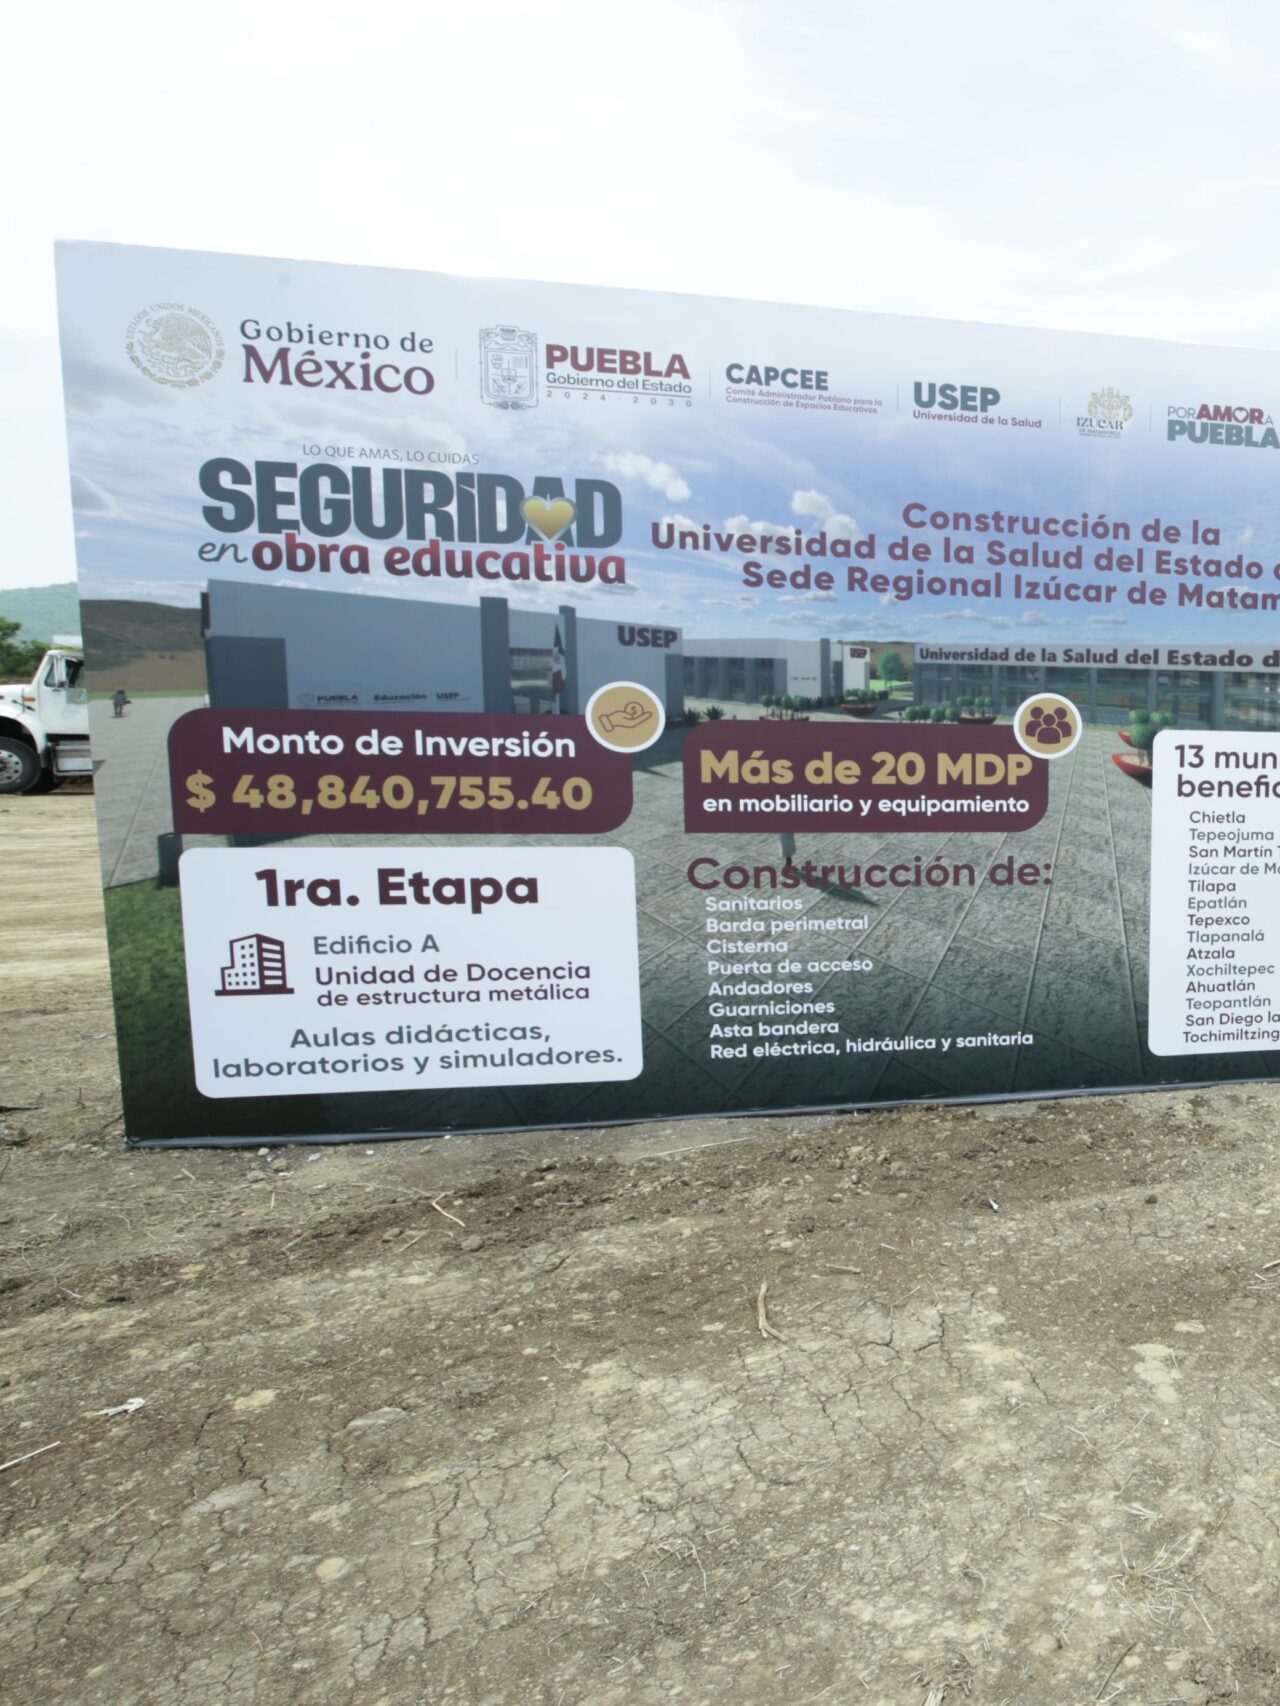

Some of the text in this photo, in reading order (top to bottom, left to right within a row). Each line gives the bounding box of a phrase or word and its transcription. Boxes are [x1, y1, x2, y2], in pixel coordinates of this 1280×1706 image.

[240, 319, 434, 354] Gobierno de
[241, 343, 435, 396] México
[546, 343, 692, 380] PUEBLA
[546, 372, 692, 395] Gobierno del Estado
[725, 363, 829, 391] CAPCEE
[725, 386, 883, 407] Comité Administrador Poblano para la
[725, 395, 878, 414] Construcción de Espacios Educativos
[913, 381, 1001, 413] USEP
[912, 409, 1042, 429] Universidad de la Salud
[1167, 403, 1274, 426] POR AMOR A
[302, 443, 480, 466] LO QUE AMAS, LO CUIDAS
[199, 456, 623, 549] SEGURIDAD
[902, 502, 1221, 546] Construcción de la
[198, 532, 627, 585] en obra educativa
[651, 521, 876, 560] Universidad
[888, 535, 932, 562] de
[943, 537, 974, 565] la
[986, 539, 1083, 570] Salud
[1094, 546, 1144, 573] del
[1155, 550, 1264, 580] Estado
[742, 560, 835, 591] Sede
[848, 566, 1002, 601] Regional
[1014, 573, 1117, 603] Izúcar
[1127, 580, 1168, 607] de
[618, 625, 678, 648] USEP
[919, 647, 1010, 663] Universidad
[1013, 648, 1037, 663] de
[1040, 648, 1058, 663] la
[1062, 647, 1119, 665] Salud
[1124, 647, 1160, 666] del
[1167, 649, 1254, 668] Estado
[222, 726, 576, 758] Monto de Inversión
[700, 750, 1033, 786] Más de 20 MDP
[1175, 744, 1205, 769] 13
[185, 769, 594, 816] $ 48,840,755.40
[703, 794, 1030, 817] en mobiliario y equipamiento
[1189, 811, 1246, 825] Chietla
[1189, 828, 1275, 844] Tepeojuma
[1188, 845, 1219, 859] San
[687, 855, 1053, 890] Construcción de:
[1188, 862, 1236, 876] Izúcar
[1240, 862, 1260, 875] de
[255, 867, 539, 914] 1ra. Etapa
[1188, 879, 1237, 895] Tilapa
[705, 896, 803, 912] Sanitarios
[1187, 897, 1248, 912] Epatlán
[706, 915, 869, 936] Barda perimetral
[1187, 914, 1250, 929] Tepexco
[313, 934, 440, 955] Edificio A
[706, 939, 788, 954] Cisterna
[1187, 929, 1265, 945] Tlapanalá
[1186, 946, 1236, 960] Atzala
[315, 961, 591, 986] Unidad de Docencia
[707, 958, 873, 976] Puerta de acceso
[1186, 963, 1276, 978] Xochiltepec
[317, 984, 590, 1007] de estructura metálica
[708, 980, 813, 996] Andadores
[1186, 980, 1256, 994] Ahuatlán
[709, 1000, 835, 1018] Guarniciones
[1186, 996, 1272, 1012] Teopantlán
[709, 1020, 839, 1038] Asta bandera
[1185, 1014, 1215, 1027] San
[1219, 1012, 1264, 1028] Diego
[1268, 1011, 1280, 1023] la
[289, 1023, 551, 1049] Aulas didácticas,
[710, 1031, 1034, 1059] Red eléctrica, hidráulica y sanitaria
[213, 1046, 623, 1079] laboratorios y simuladores.
